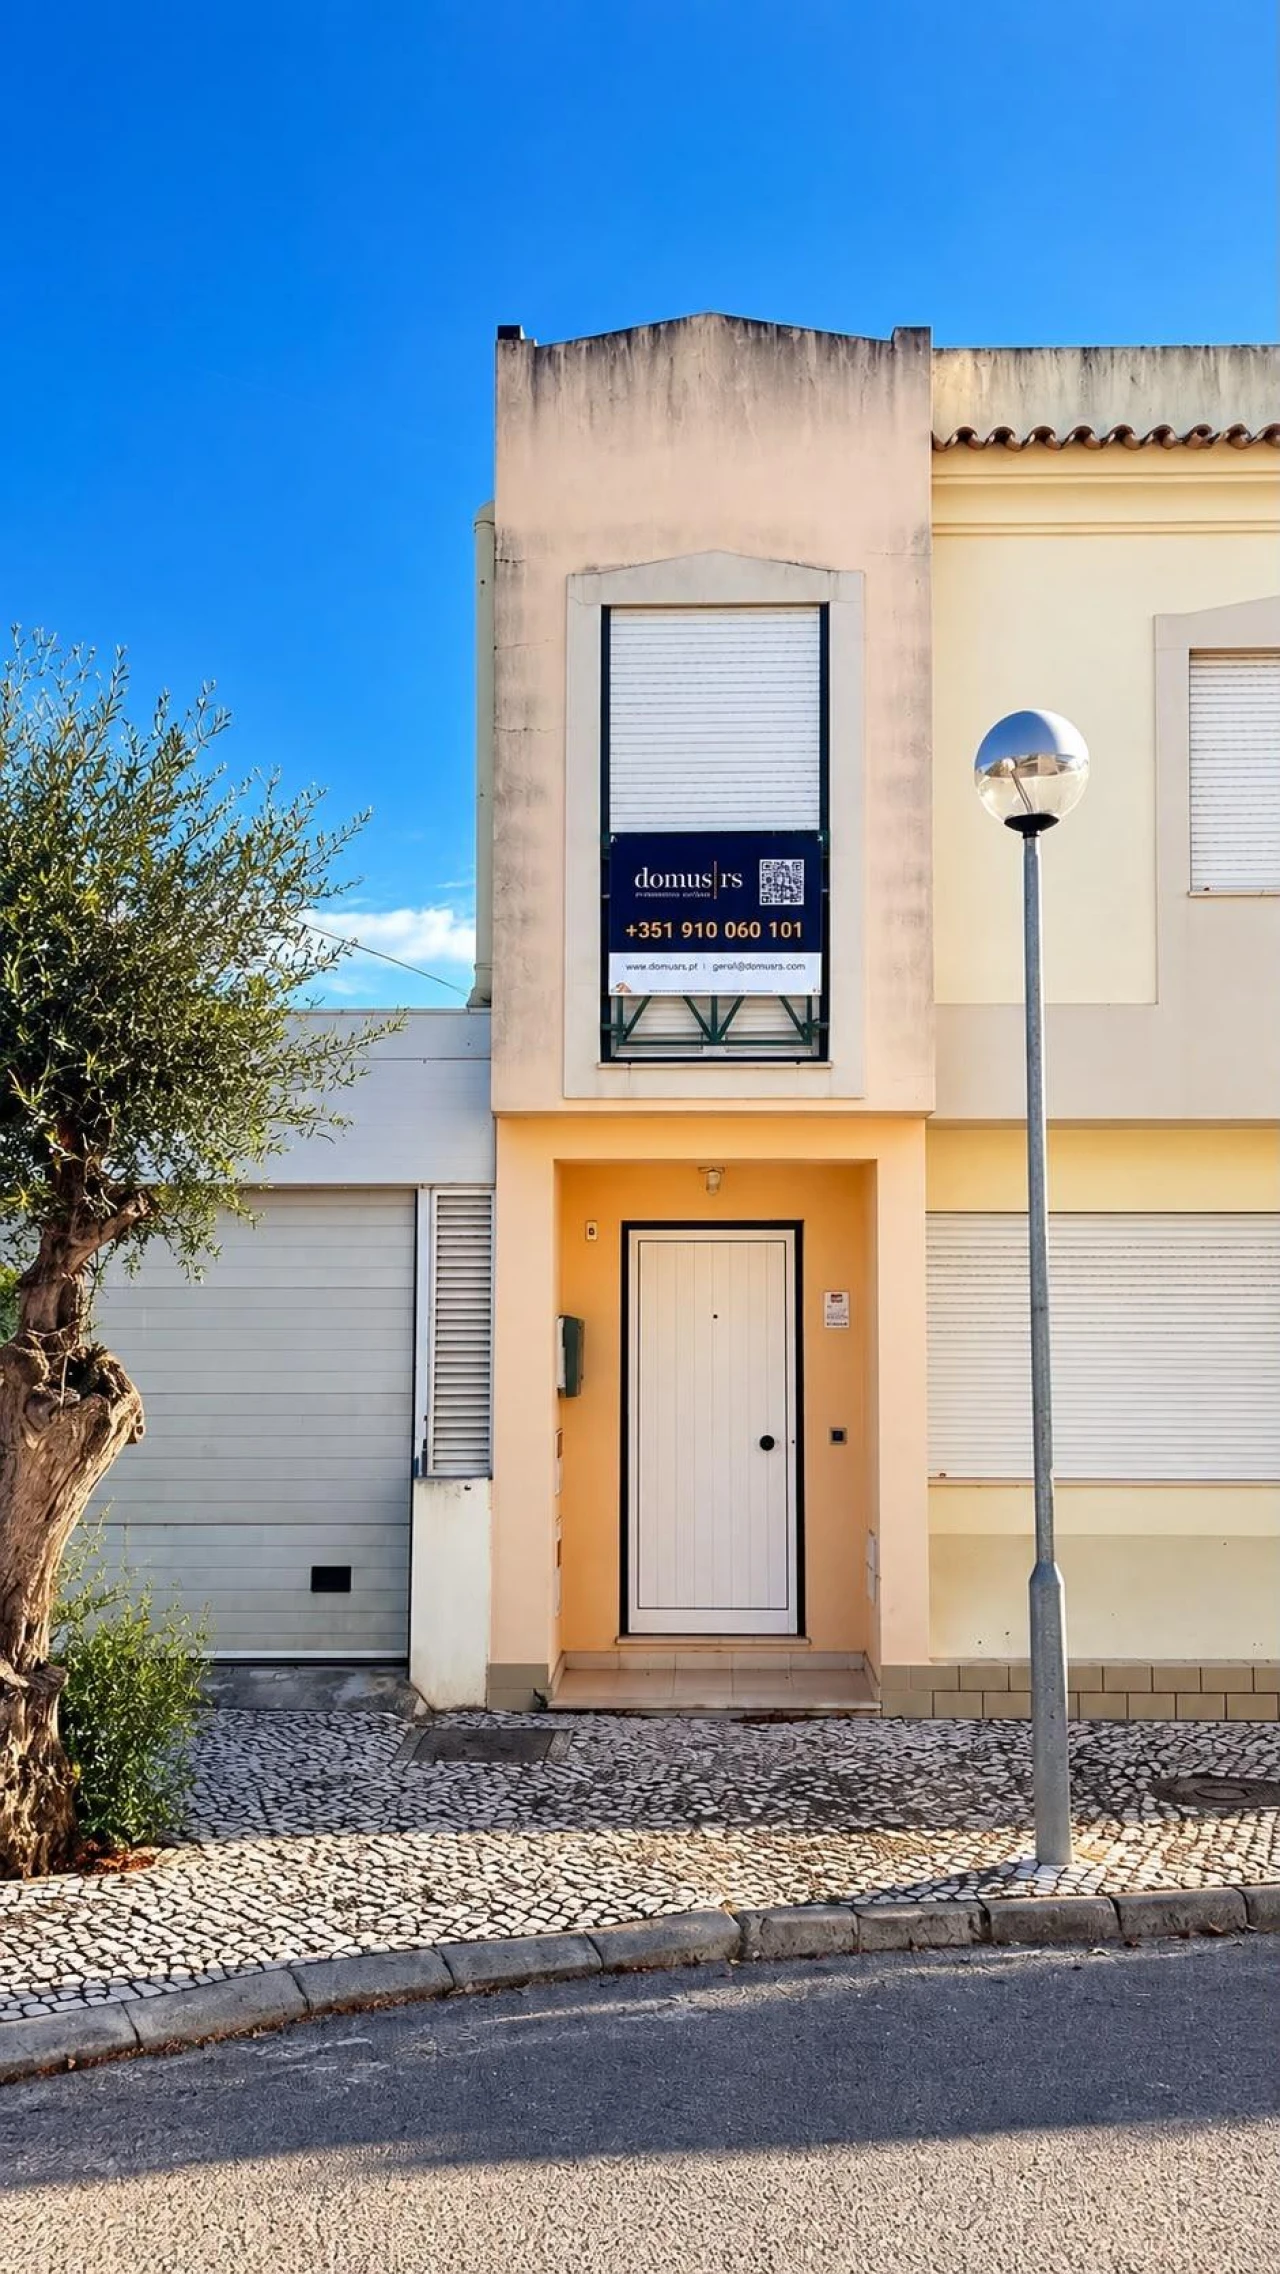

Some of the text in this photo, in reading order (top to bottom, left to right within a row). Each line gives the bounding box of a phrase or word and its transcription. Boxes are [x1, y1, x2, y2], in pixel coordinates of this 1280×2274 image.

[634, 867, 713, 889] domus
[625, 921, 802, 939] +351 910 060 101
[626, 962, 806, 972] www.domusrs.pt geral@domusrs.com
